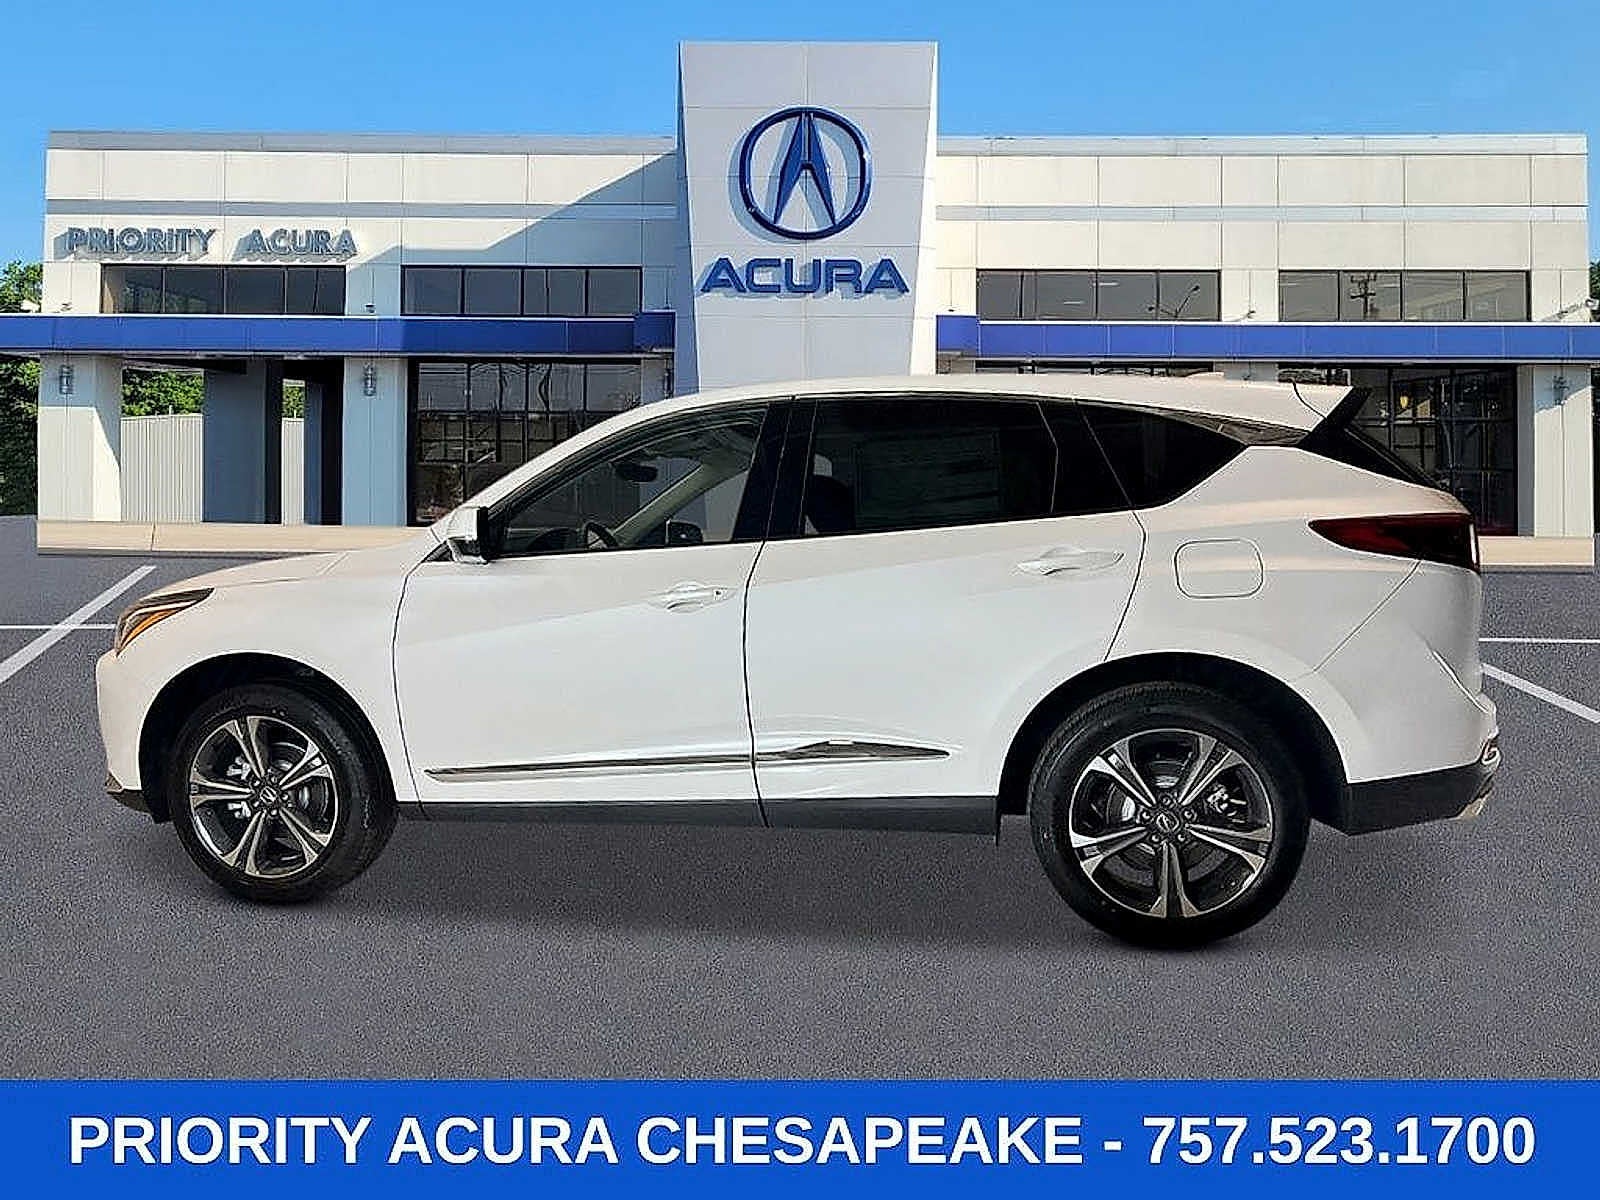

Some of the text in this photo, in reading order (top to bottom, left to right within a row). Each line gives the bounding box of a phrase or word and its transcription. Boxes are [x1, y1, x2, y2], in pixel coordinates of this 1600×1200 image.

[66, 226, 357, 257] PRIORITY ACURA
[700, 257, 909, 294] ACURA
